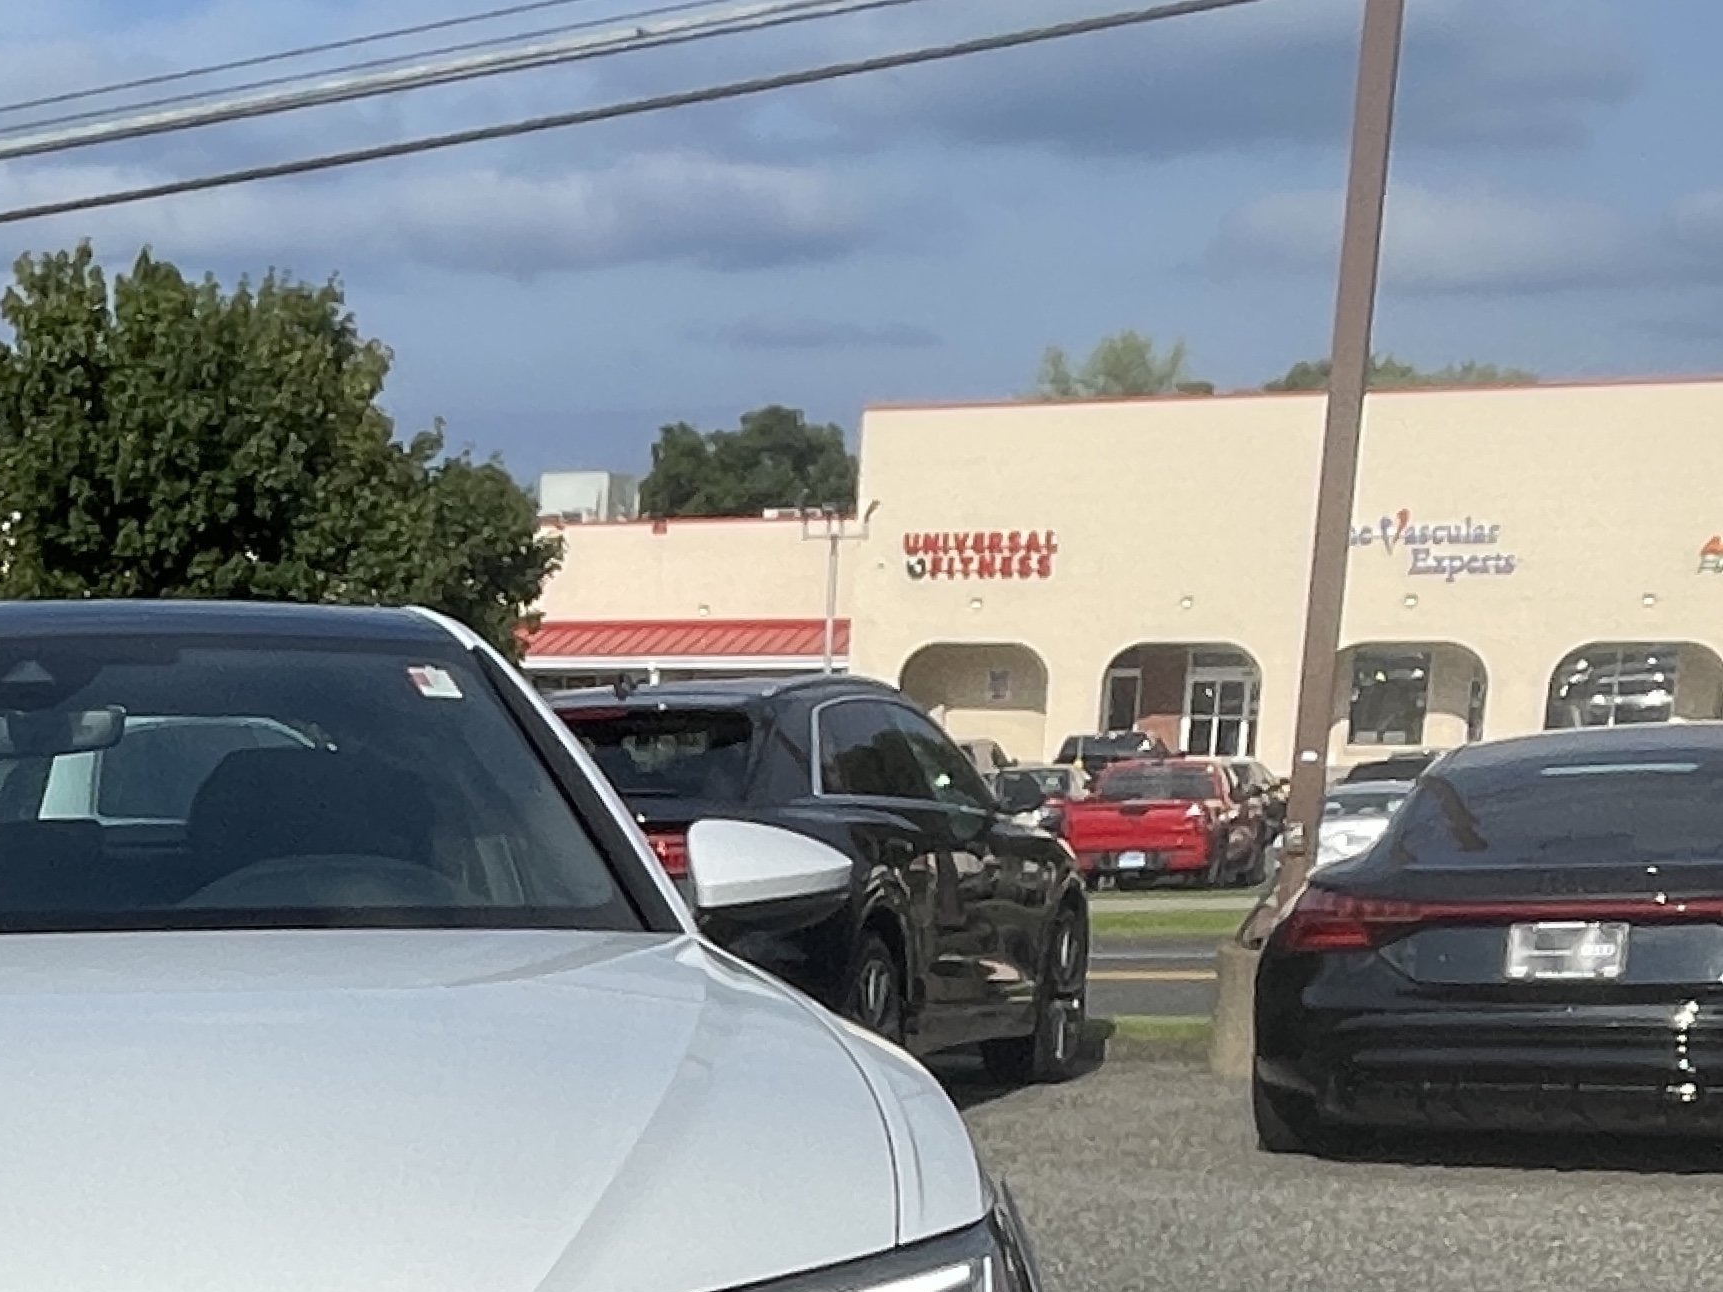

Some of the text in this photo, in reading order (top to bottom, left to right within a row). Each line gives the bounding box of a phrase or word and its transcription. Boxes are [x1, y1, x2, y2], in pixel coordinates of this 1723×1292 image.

[904, 531, 1058, 556] UNIVERSAL
[1380, 508, 1500, 555] Vascular
[929, 554, 1052, 580] FITNESS
[1407, 548, 1516, 582] Experts
